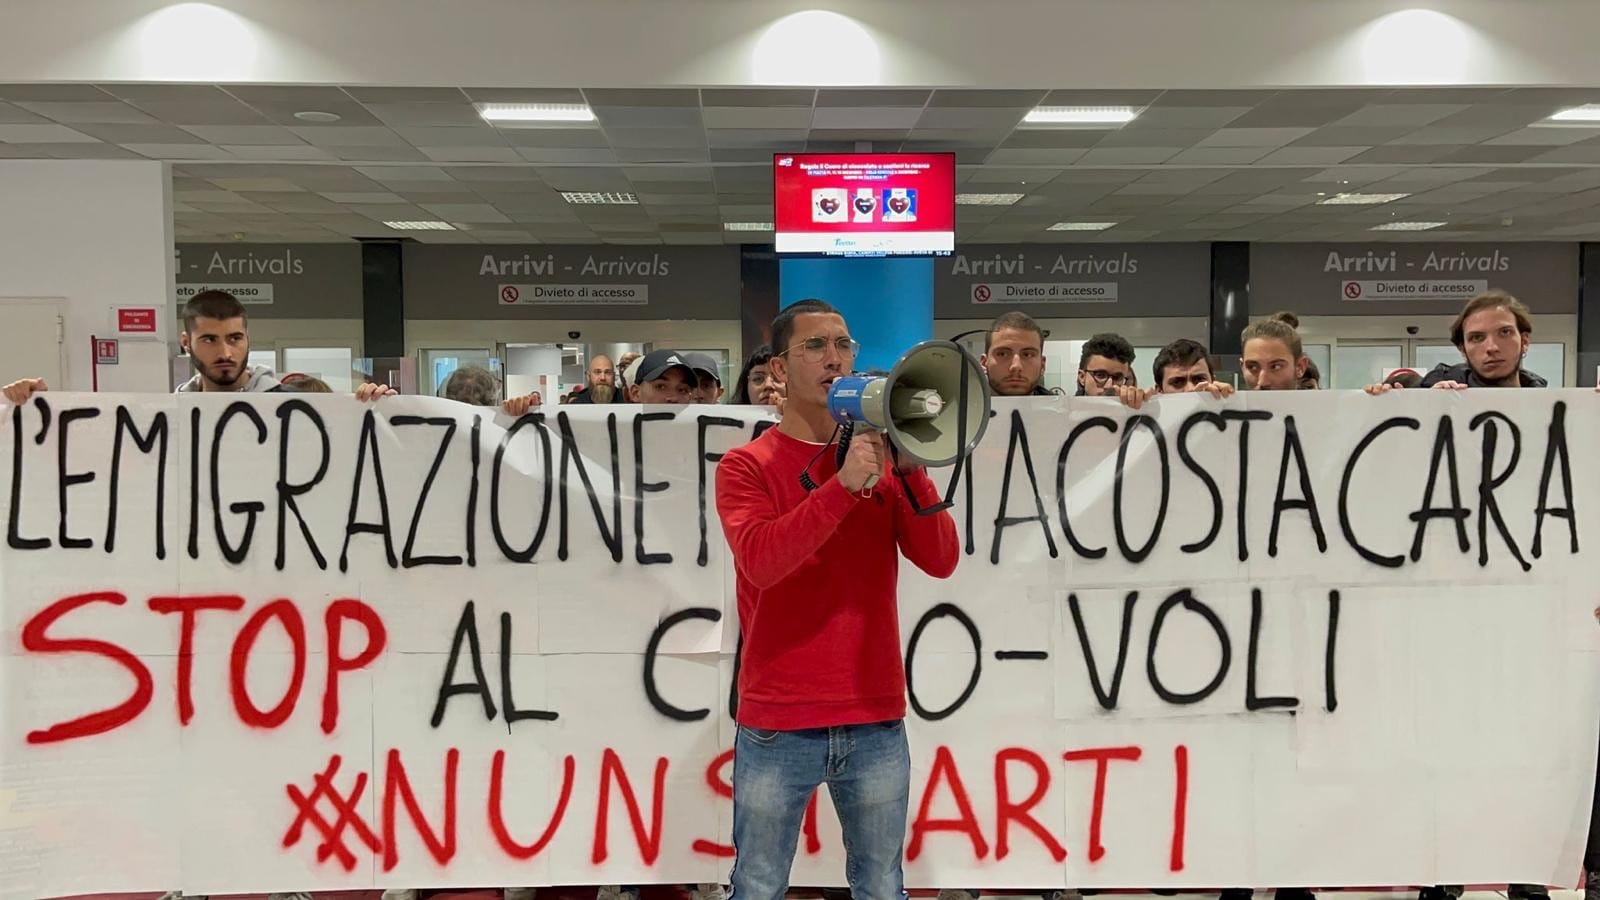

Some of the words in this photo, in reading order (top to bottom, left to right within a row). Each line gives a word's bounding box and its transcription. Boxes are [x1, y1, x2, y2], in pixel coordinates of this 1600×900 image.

[207, 249, 304, 275] Arrivals
[478, 254, 555, 277] Arrivi
[580, 253, 670, 277] Arrivals
[951, 253, 1025, 276] Arrivi
[1050, 252, 1138, 275] Arrivals
[1323, 250, 1397, 273] Arrivi
[1422, 250, 1510, 272] Arrivals
[534, 286, 575, 298] Divieto
[578, 286, 589, 298] di
[591, 289, 635, 298] accesso
[1006, 285, 1045, 297] Divieto
[1048, 285, 1059, 297] di
[1062, 287, 1105, 297] accesso
[1376, 282, 1416, 294] Divieto
[1419, 282, 1429, 294] di
[1431, 285, 1475, 294] accesso
[7, 397, 675, 573] L'EMIGRAZIONE
[1057, 410, 1327, 564] COSTA
[1338, 401, 1579, 571] CARA
[22, 592, 387, 735] STOP
[431, 601, 559, 734] AL
